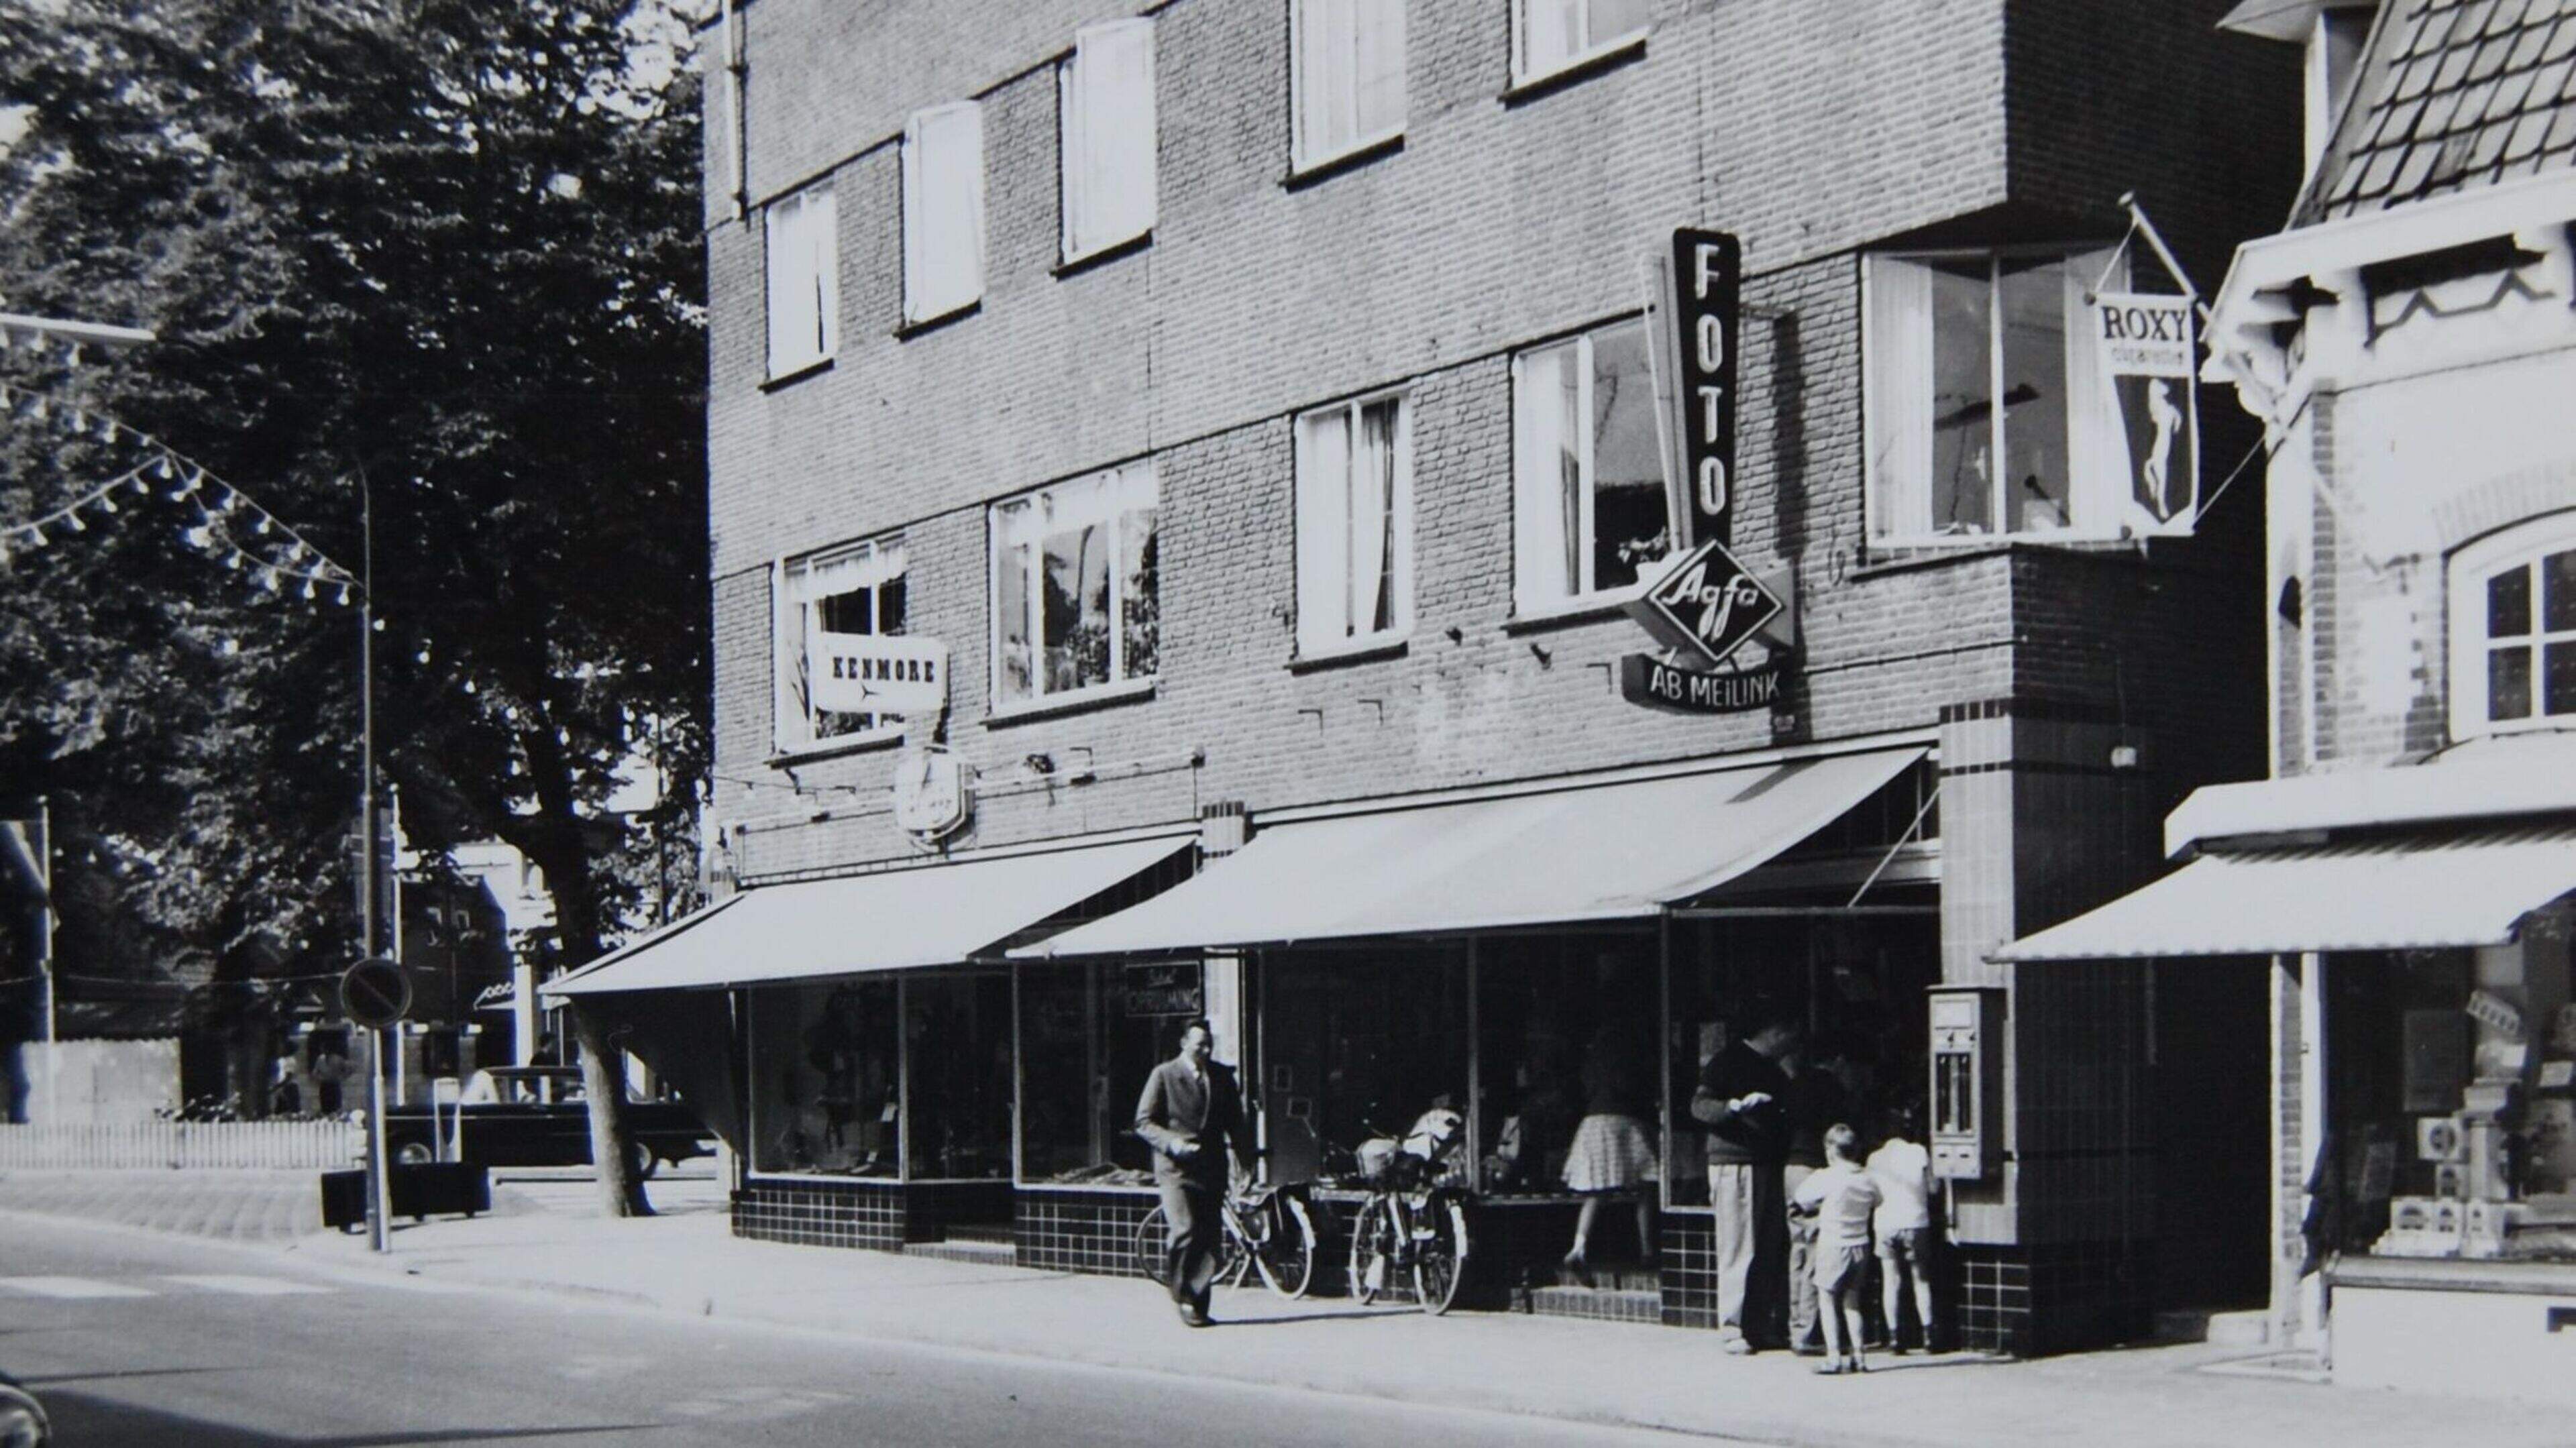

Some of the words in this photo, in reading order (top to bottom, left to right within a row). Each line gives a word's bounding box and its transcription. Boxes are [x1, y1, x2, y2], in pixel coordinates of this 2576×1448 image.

[2100, 305, 2186, 342] ROXY
[1695, 243, 1726, 516] FOTO
[1660, 561, 1760, 643] Agfa
[833, 656, 934, 683] KENMORE
[1650, 665, 1682, 700] AB
